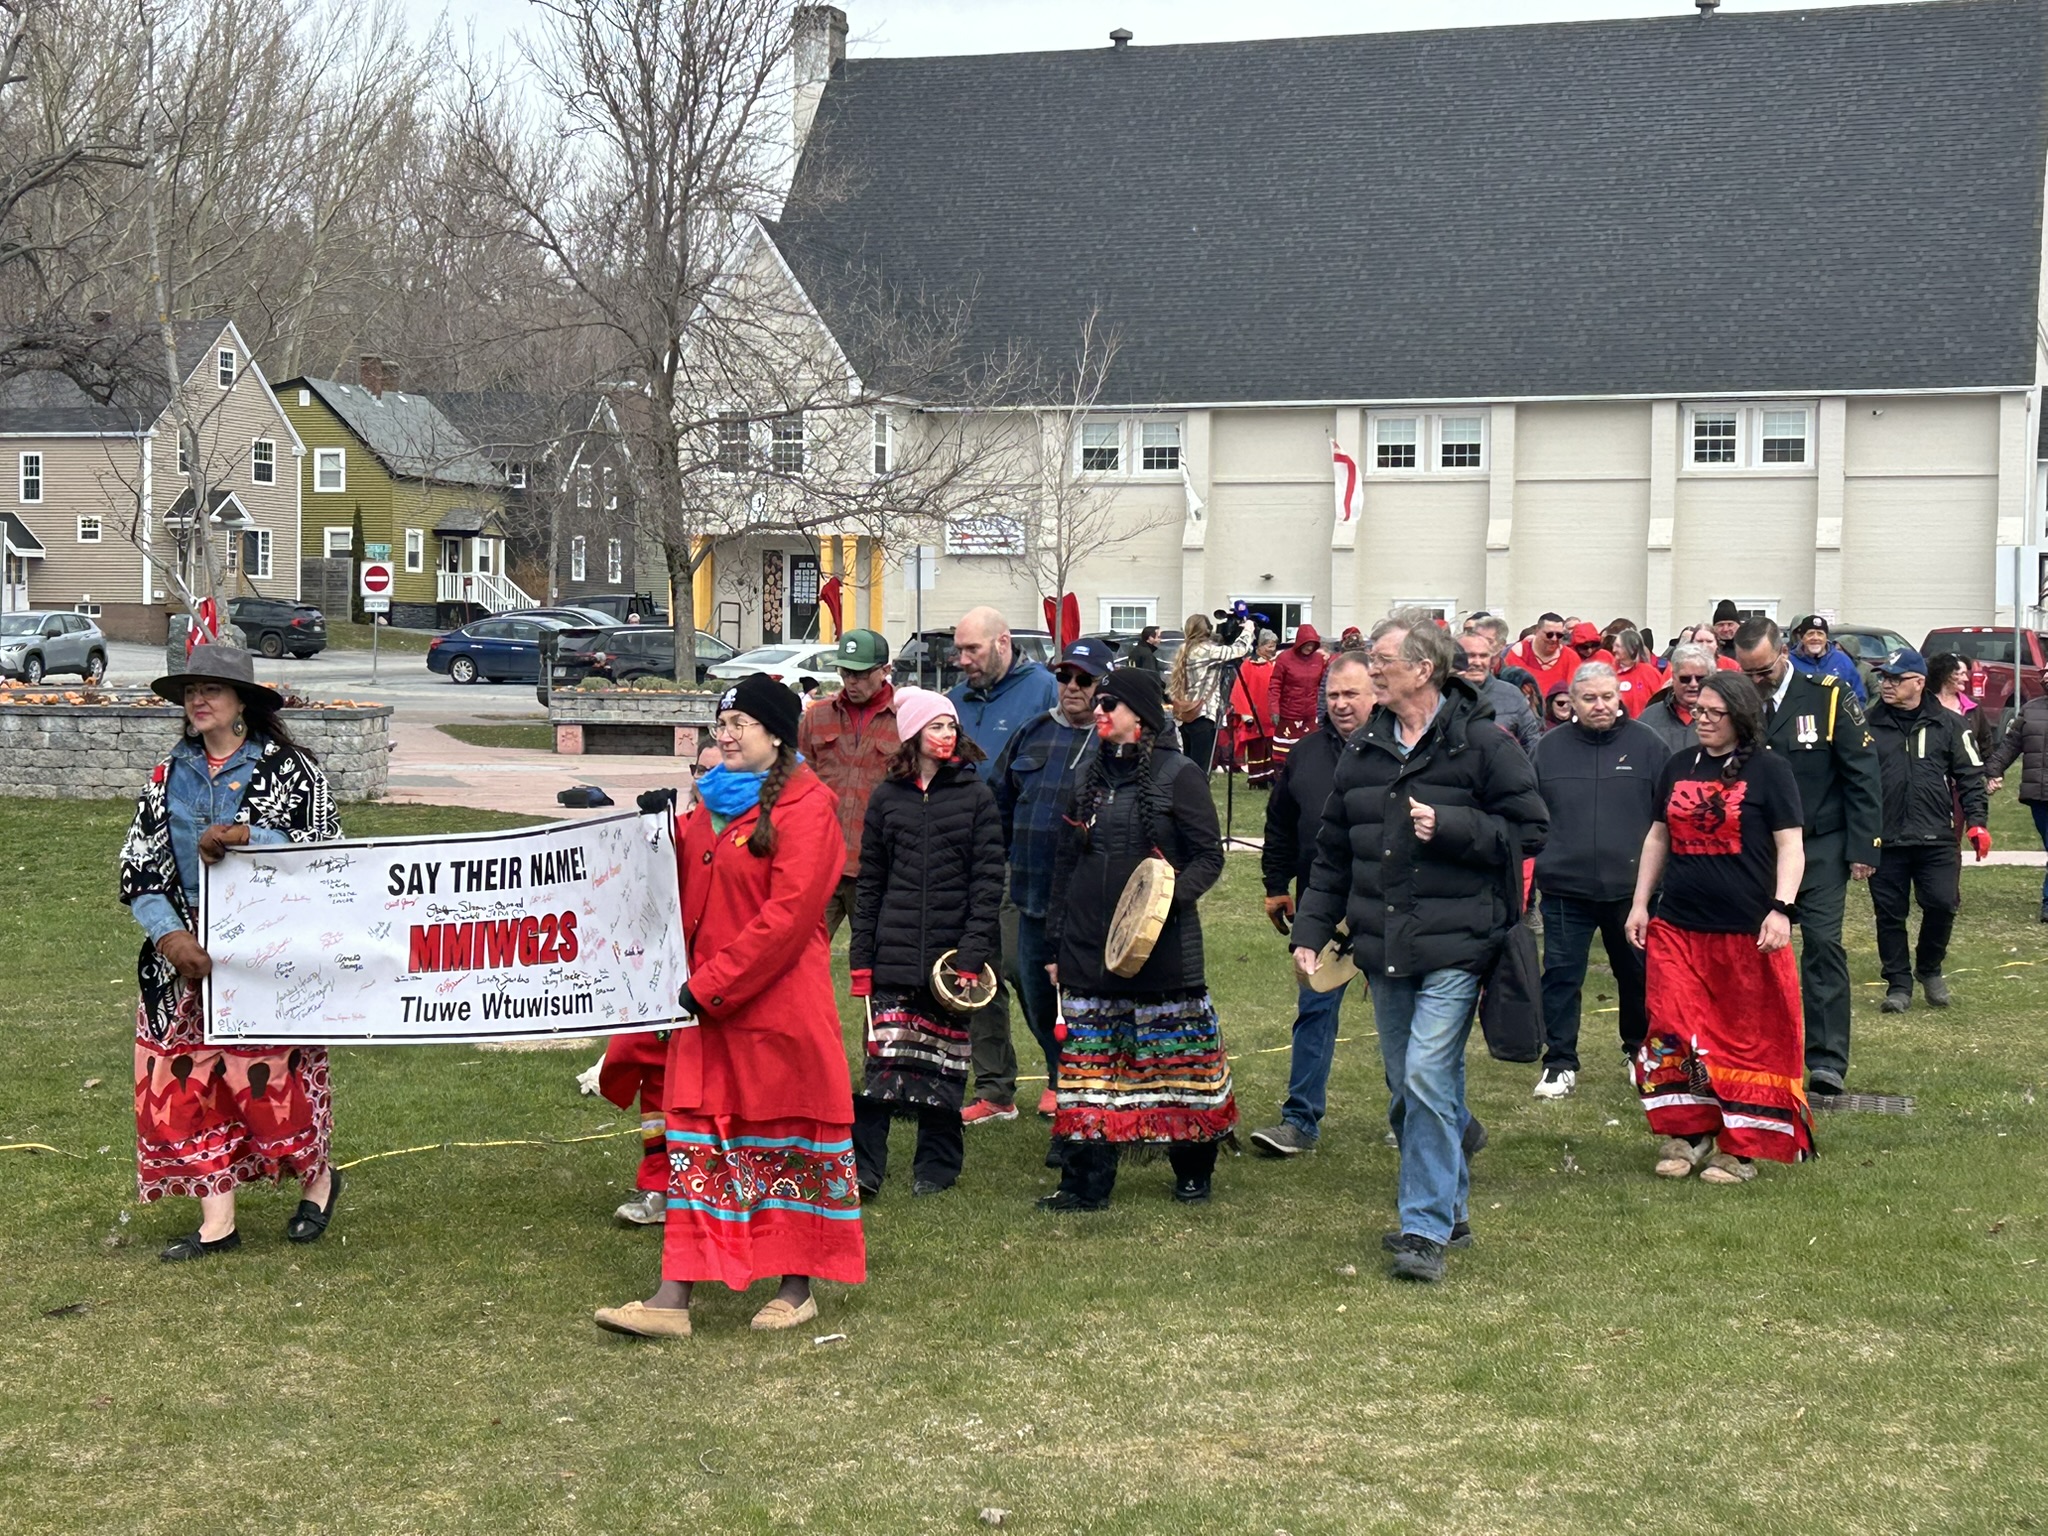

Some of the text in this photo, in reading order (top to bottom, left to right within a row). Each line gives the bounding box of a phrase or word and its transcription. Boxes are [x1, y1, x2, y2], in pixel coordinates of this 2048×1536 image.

[387, 863, 442, 896] SAY
[450, 856, 522, 893] THEIR
[530, 846, 587, 887] NAME!
[408, 909, 579, 974] MMIWG2S
[400, 996, 471, 1023] Tluwe
[482, 988, 593, 1020] Wtuwisum
